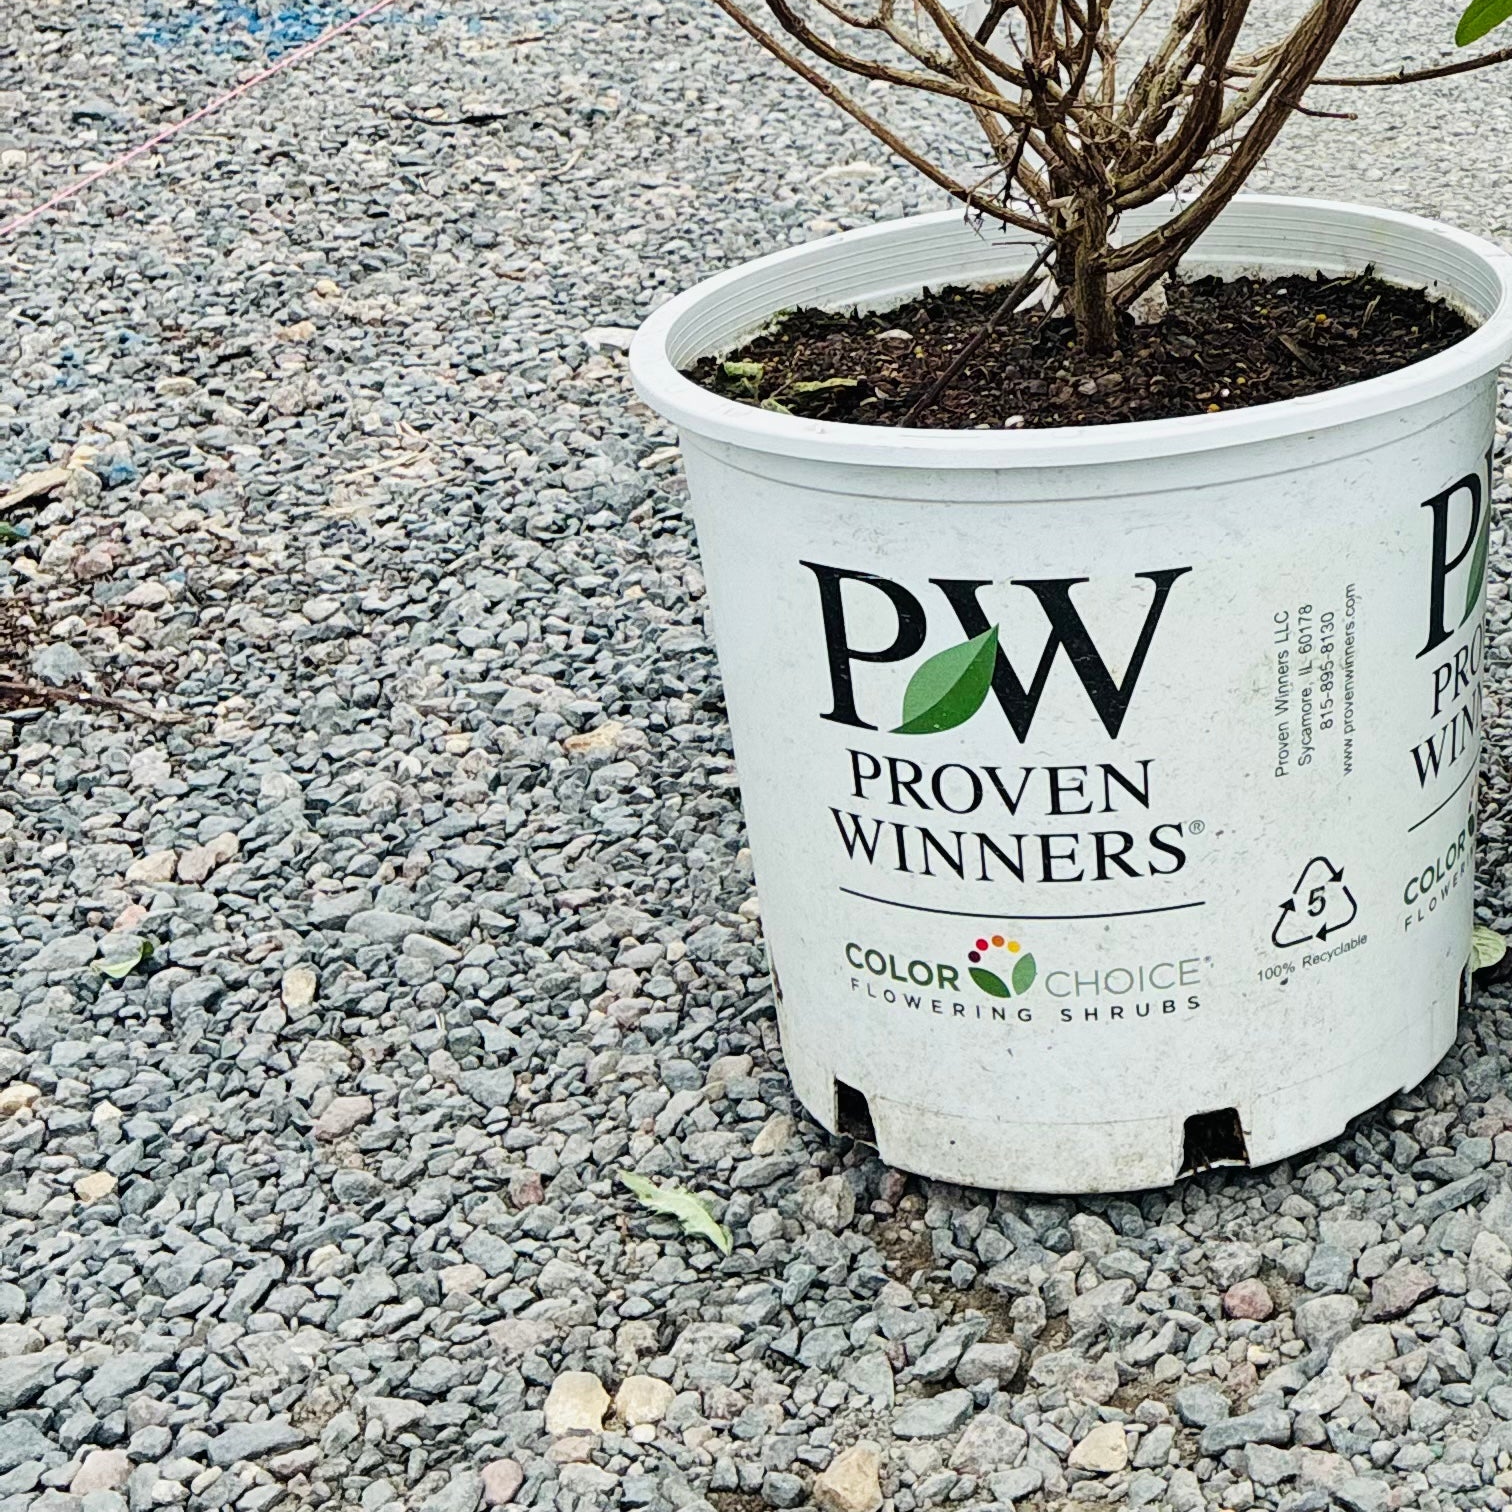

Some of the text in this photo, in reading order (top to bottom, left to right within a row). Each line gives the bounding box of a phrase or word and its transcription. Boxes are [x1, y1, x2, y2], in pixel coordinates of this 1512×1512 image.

[799, 560, 1194, 745] PW
[1298, 604, 1316, 767] Sycamore, IL 60178
[1320, 611, 1335, 731] 815-895-8130
[1430, 622, 1484, 720] PRO
[1274, 610, 1290, 778] Proven Winners LLC
[845, 748, 1155, 816] PROVEN
[1307, 885, 1327, 917] 5
[1403, 828, 1466, 906] COLOR
[845, 942, 961, 991] COLOR
[1257, 934, 1368, 982] 100% Recyclable
[851, 977, 1201, 1023] FLOWERING SHRUBS
